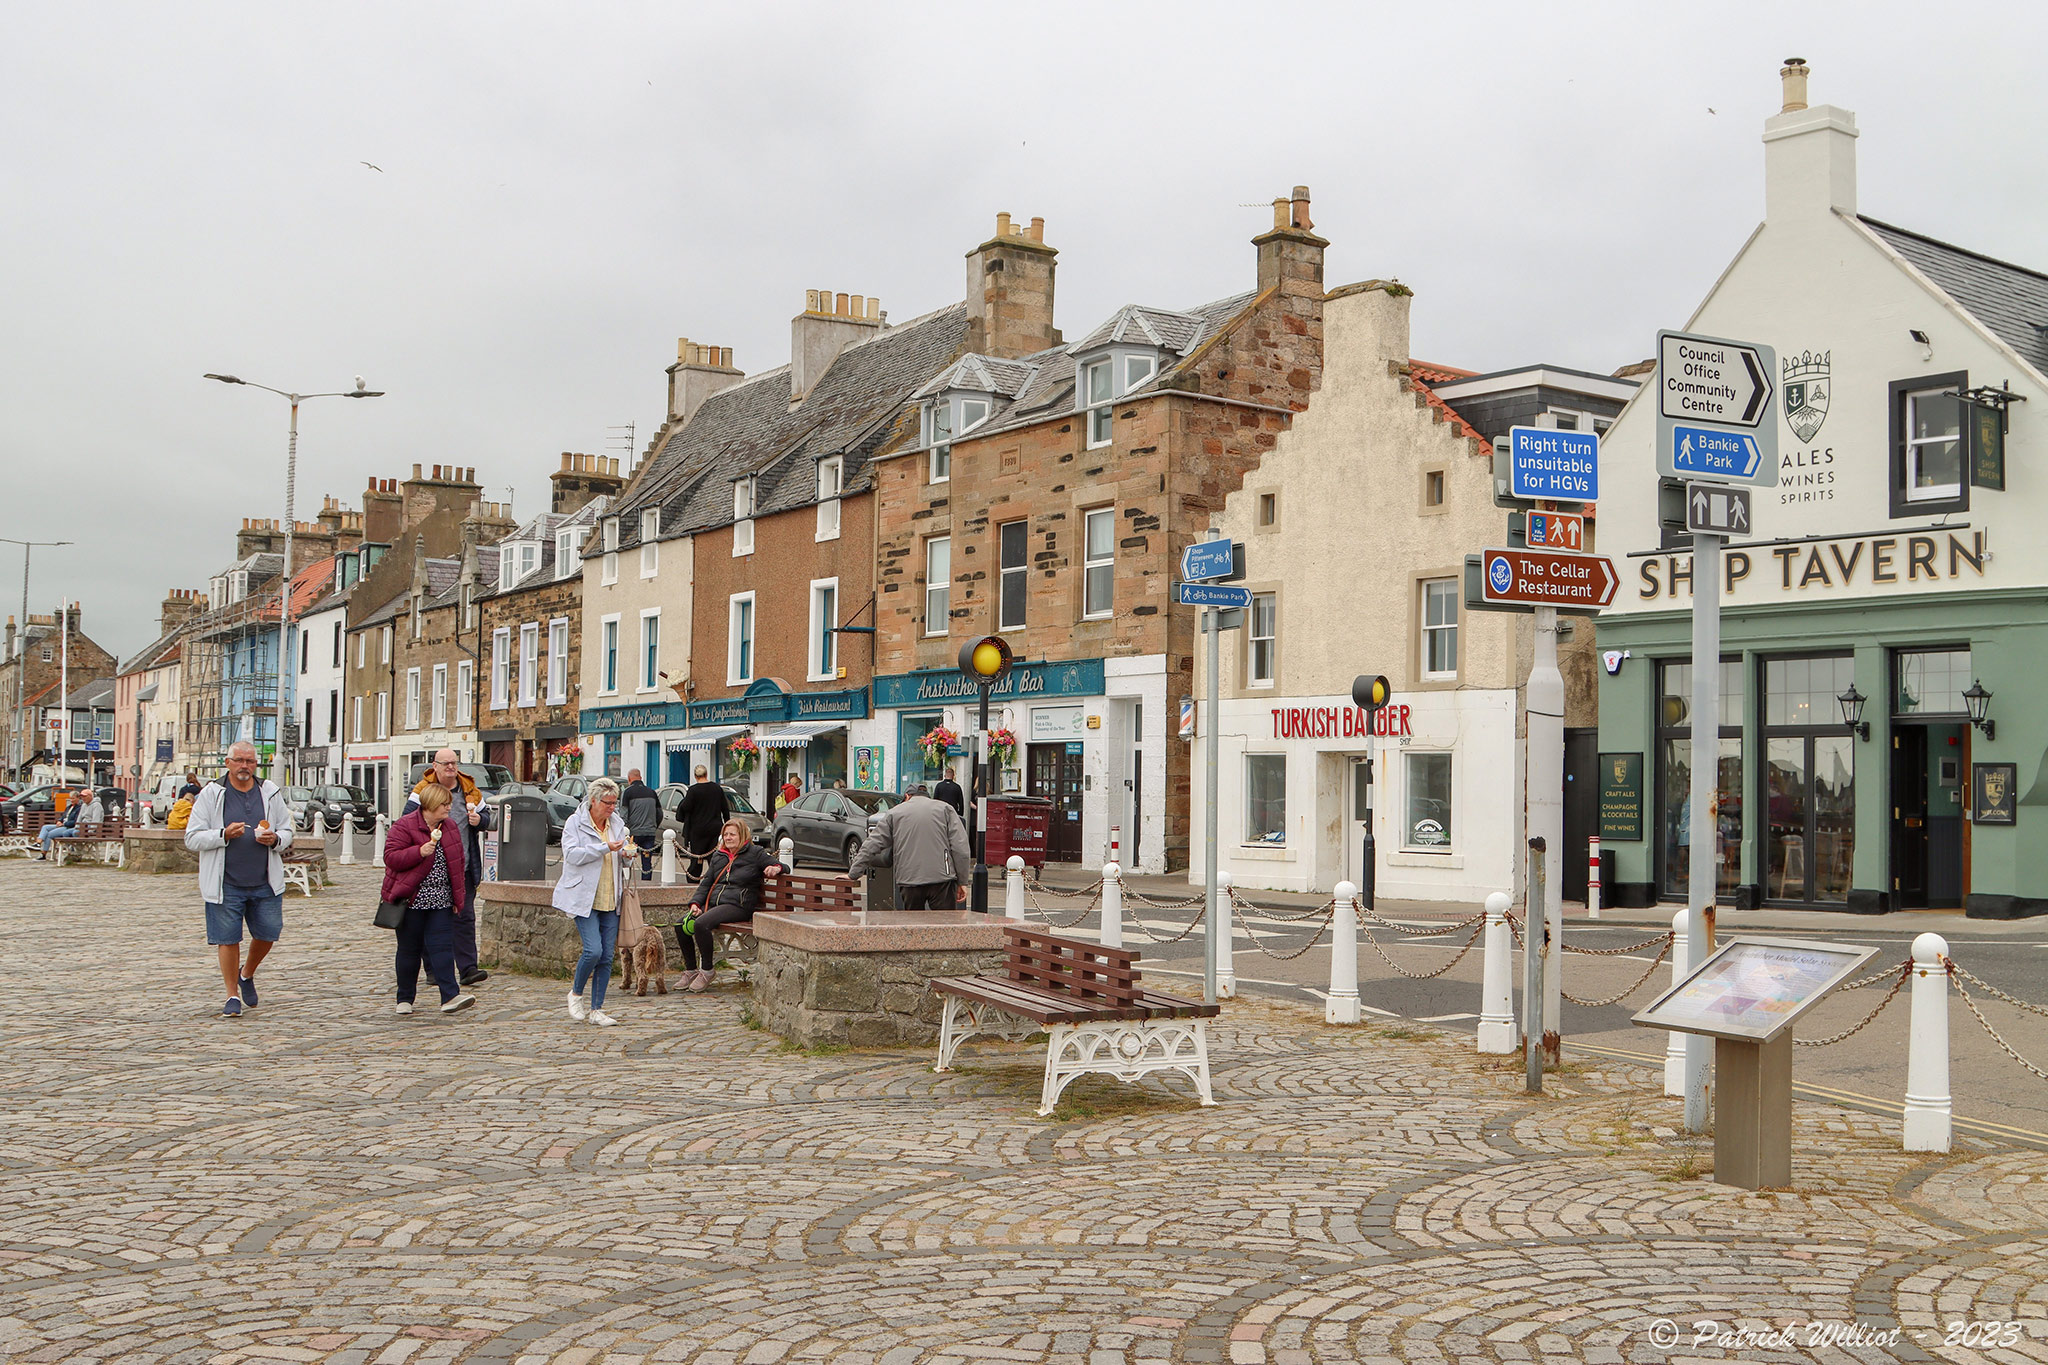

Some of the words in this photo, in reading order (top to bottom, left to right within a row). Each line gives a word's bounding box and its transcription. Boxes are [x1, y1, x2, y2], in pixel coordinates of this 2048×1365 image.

[1679, 345, 1725, 364] Council
[1684, 363, 1720, 380] Office
[1668, 378, 1736, 401] Community
[1682, 397, 1723, 414] Centre
[1520, 435, 1557, 454] Right
[1562, 439, 1592, 455] turn
[1699, 435, 1740, 452] Bankie
[1519, 457, 1593, 473] unsuitable
[1706, 453, 1733, 468] Park
[1781, 448, 1834, 469] ALES
[1523, 473, 1544, 489] for
[1550, 475, 1589, 492] HGVs
[1781, 471, 1835, 487] WINES
[1781, 489, 1834, 505] SPIRITS
[1520, 559, 1544, 576] The
[1550, 562, 1591, 578] Cellar
[1639, 551, 1752, 601] SHP
[1773, 530, 1986, 590] TAVERN
[1208, 591, 1229, 600] Bankie
[1518, 579, 1592, 598] Restaurant
[917, 676, 978, 699] Anstruther
[1020, 669, 1044, 693] Bar
[704, 705, 711, 715] &
[798, 699, 813, 715] Fish
[814, 698, 852, 714] Restaurant
[594, 712, 613, 728] Home
[613, 711, 633, 727] Made
[633, 709, 643, 727] Ice
[643, 709, 666, 728] Cream
[1271, 706, 1339, 738] TURKISH
